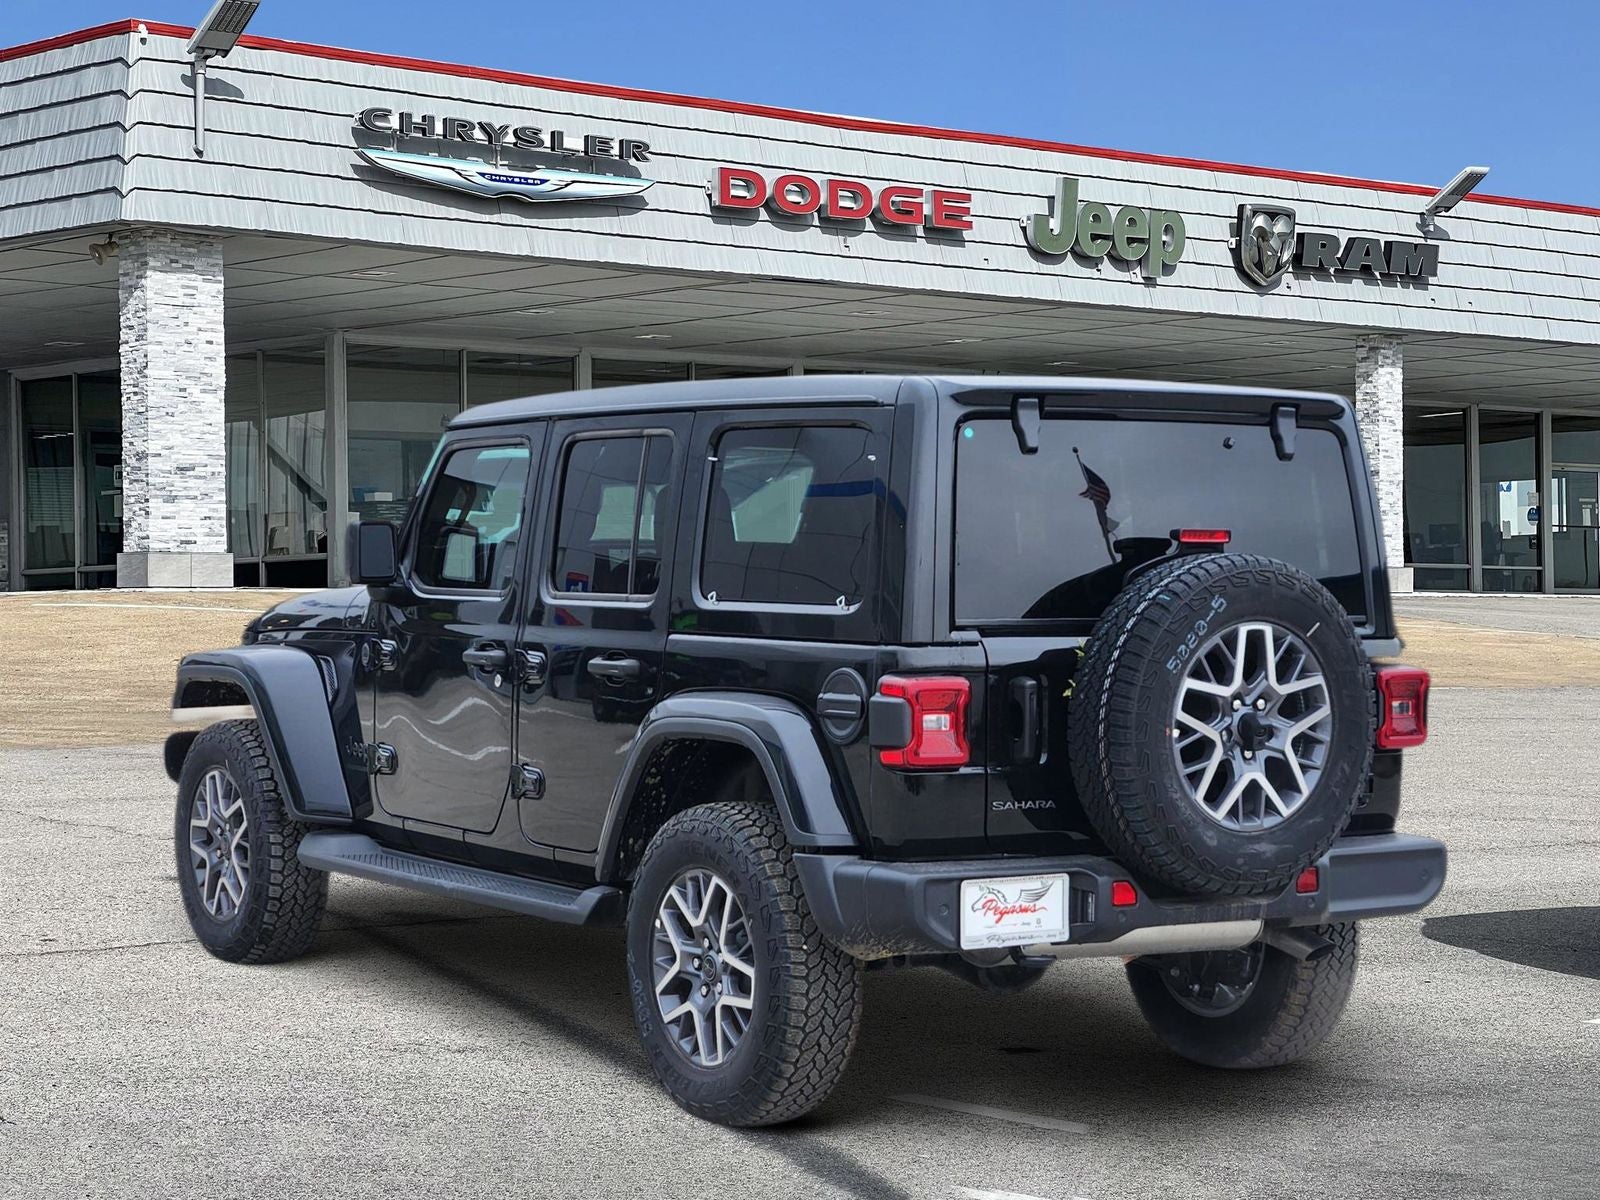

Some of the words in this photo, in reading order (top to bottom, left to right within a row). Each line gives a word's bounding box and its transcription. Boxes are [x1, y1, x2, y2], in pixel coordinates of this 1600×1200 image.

[359, 107, 650, 163] CHRYSLER
[483, 174, 542, 185] CHRYSLER
[709, 166, 974, 244] DODGE
[1023, 176, 1186, 279] Jeep
[1298, 231, 1440, 278] RAM
[991, 800, 1057, 811] SAHARA
[981, 898, 1048, 925] Pegasus
